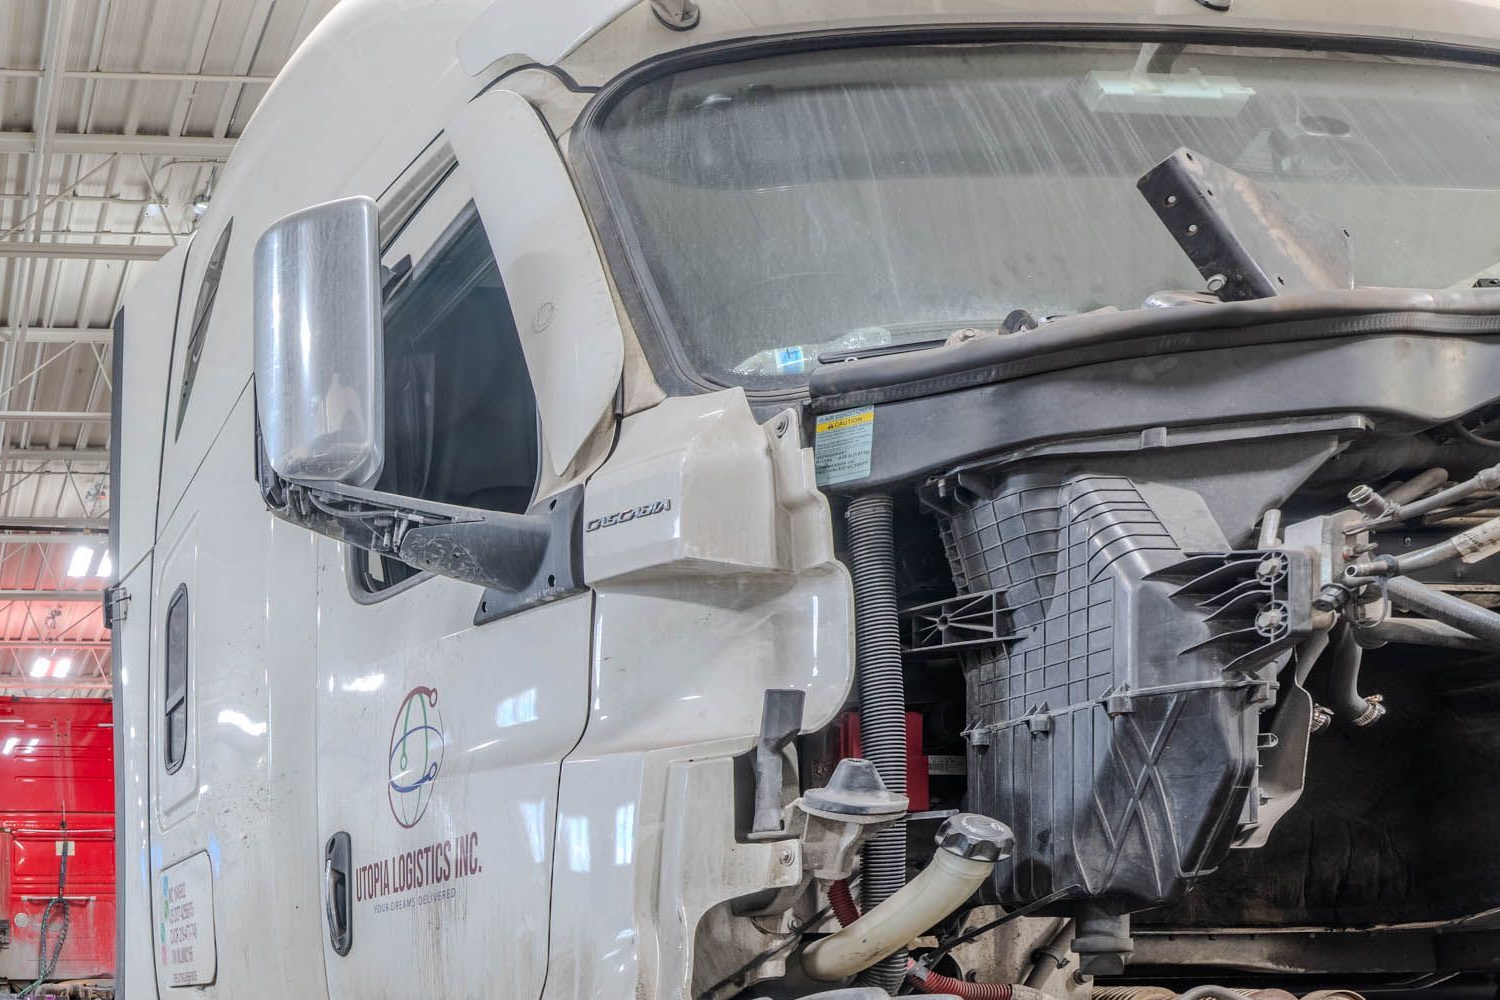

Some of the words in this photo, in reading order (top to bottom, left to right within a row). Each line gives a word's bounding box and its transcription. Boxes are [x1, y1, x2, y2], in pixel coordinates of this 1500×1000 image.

[834, 416, 863, 428] CAUTION
[586, 498, 671, 533] CASCADIA
[355, 859, 390, 902] UTOPIA
[392, 840, 451, 893] LOGISTICS
[455, 831, 482, 879] INC.
[373, 900, 389, 914] YOUR
[390, 897, 416, 911] DREAMS
[418, 888, 456, 905] DELIVERED
